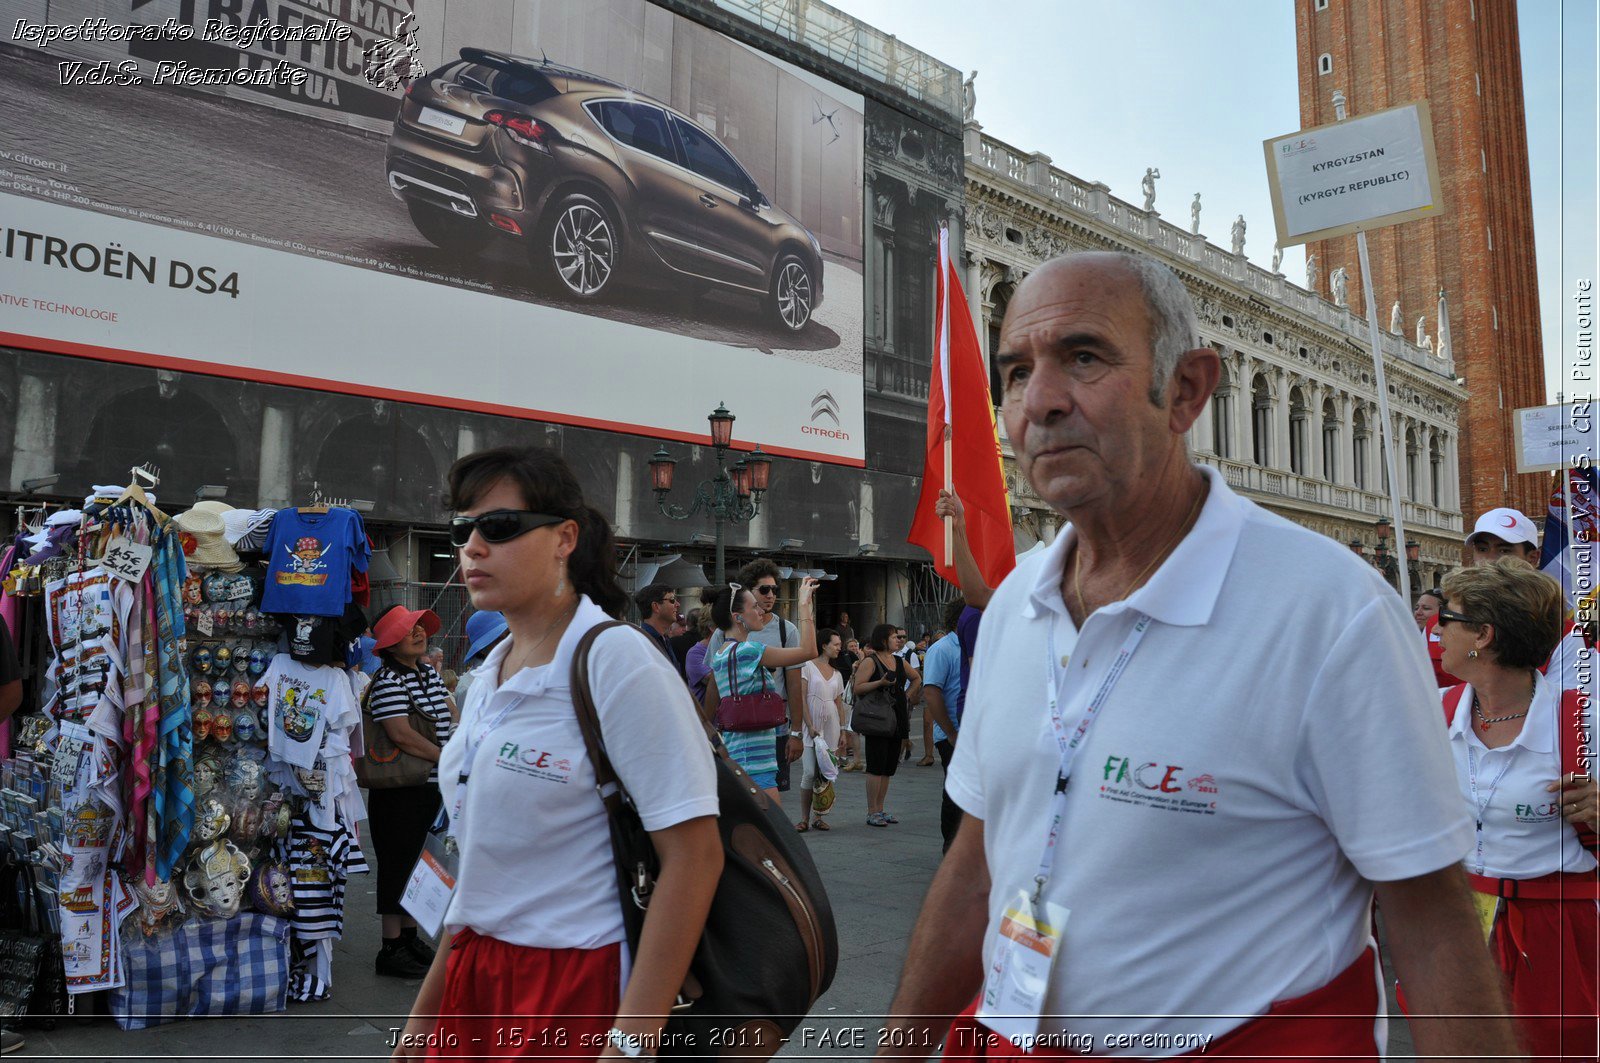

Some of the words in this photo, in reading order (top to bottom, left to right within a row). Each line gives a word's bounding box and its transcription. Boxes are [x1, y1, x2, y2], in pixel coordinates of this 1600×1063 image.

[1312, 147, 1386, 173] KYRGYZSTAN
[1298, 185, 1347, 206] (KYRGYZ
[1349, 169, 1411, 193] REPUBLIC)
[13, 181, 34, 193] DS4
[36, 187, 51, 197] 1.6
[53, 190, 71, 202] THP
[72, 195, 91, 207] 200
[91, 201, 127, 214] consumo
[128, 207, 138, 217] su
[139, 210, 172, 224] percorso
[174, 217, 196, 229] misto:
[251, 233, 284, 247] Emissioni
[284, 239, 291, 248] di
[307, 246, 316, 254] su
[316, 249, 344, 263] percorso
[399, 265, 407, 273] La
[407, 266, 419, 276] foto
[424, 271, 444, 281] inserita
[0, 227, 157, 285] ITROËN
[168, 259, 241, 300] DS4
[32, 299, 119, 323] TECHNOLOGIE
[801, 425, 850, 441] CITROËN
[1548, 438, 1580, 448] (SEBIA)
[500, 742, 552, 768] FACE
[1103, 755, 1184, 793] FACE
[1131, 791, 1170, 804] Convention
[1515, 803, 1558, 818] FACE
